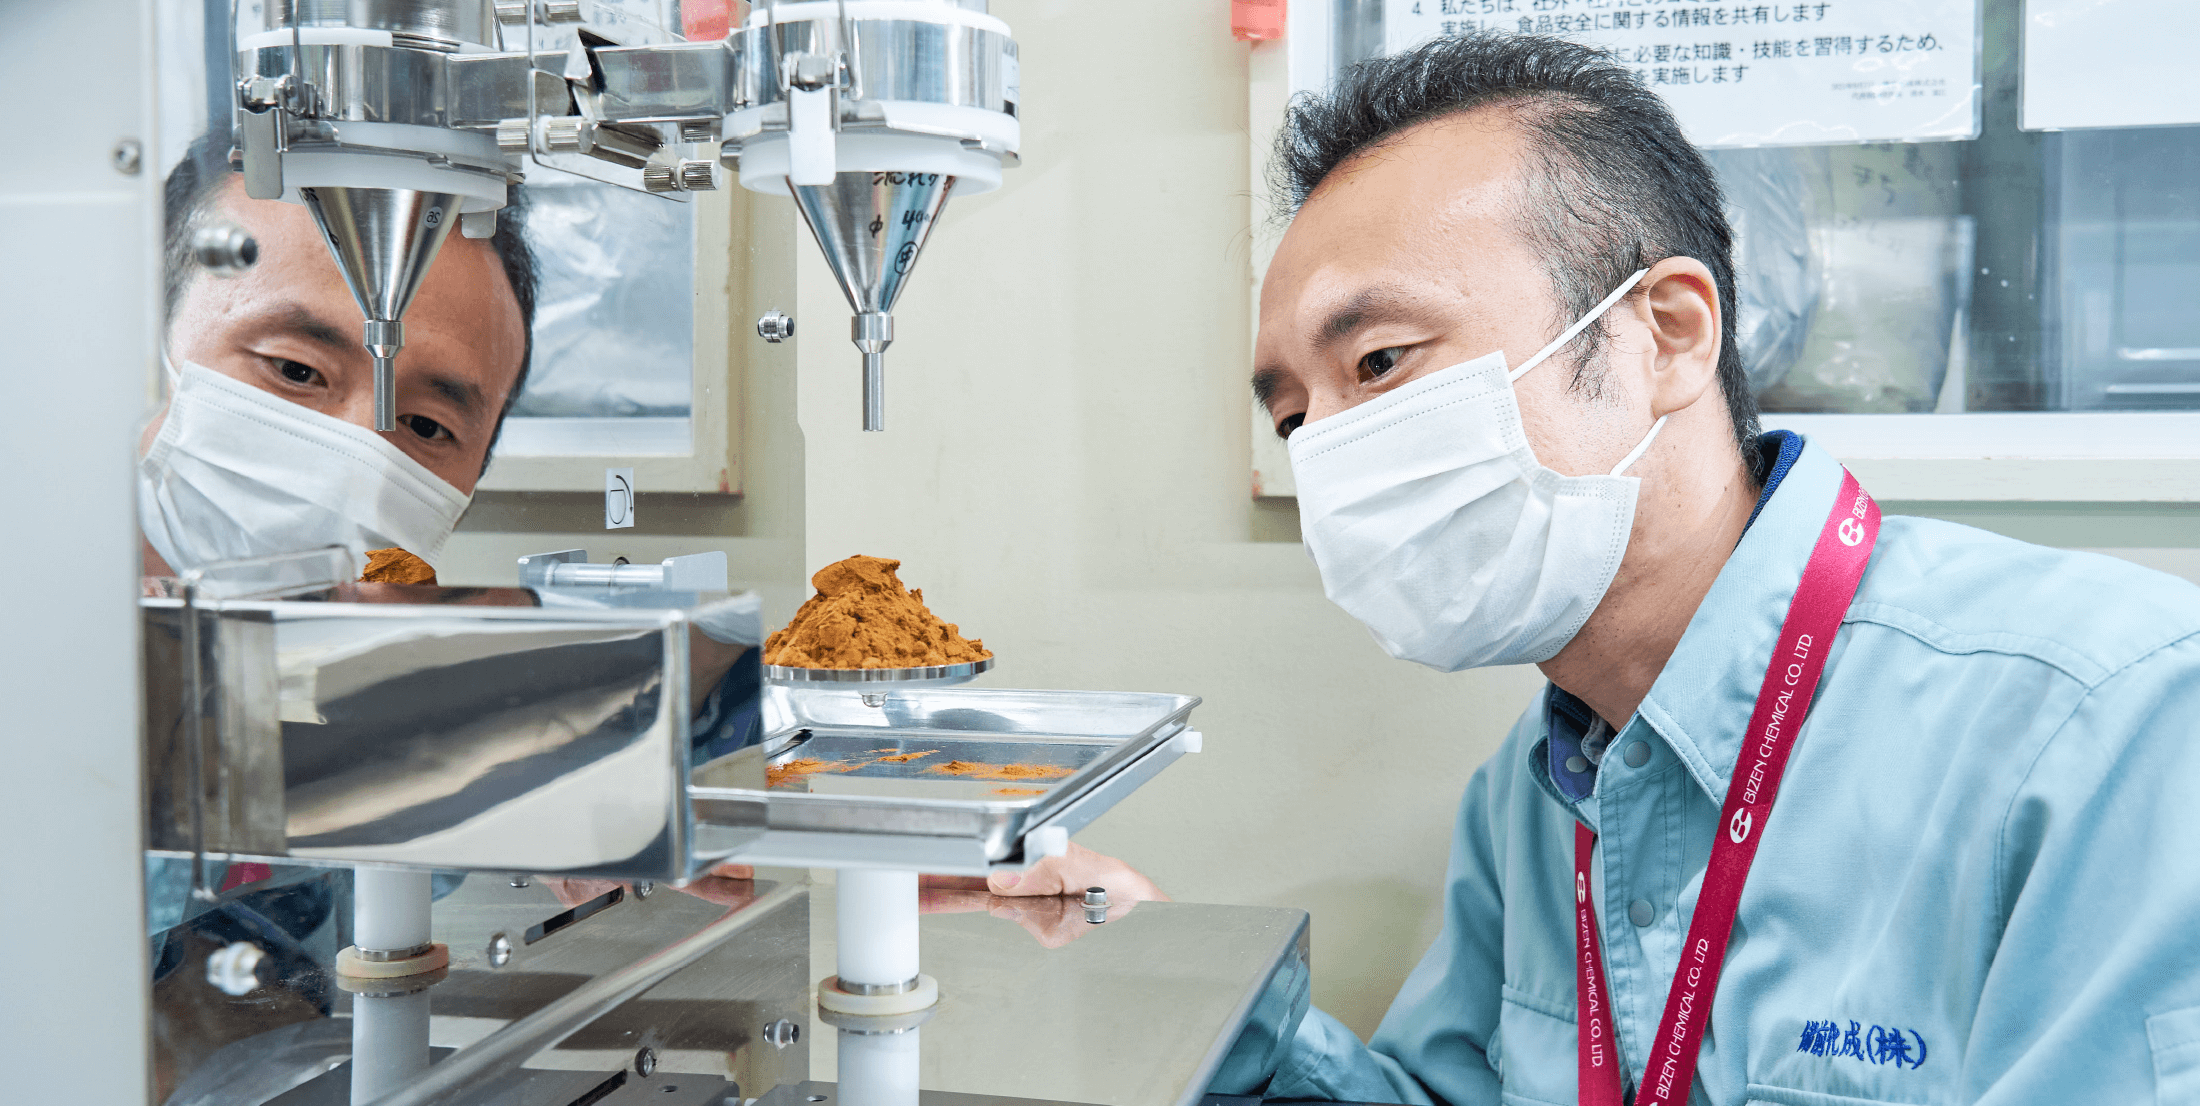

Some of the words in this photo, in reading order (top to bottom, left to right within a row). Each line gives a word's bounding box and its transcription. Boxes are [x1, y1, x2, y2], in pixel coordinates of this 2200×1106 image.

[1742, 759, 1768, 804] BIZEN
[1759, 689, 1794, 758] CHEMICAL
[1793, 633, 1815, 660] LTD.
[1580, 908, 1591, 949] BIZEN
[1584, 951, 1599, 1017] CHEMICAL
[1655, 1056, 1678, 1100] BIZEN
[1668, 990, 1696, 1056] CHEMICAL
[1693, 938, 1710, 964] LTD.
[1591, 1043, 1604, 1068] LTD.
